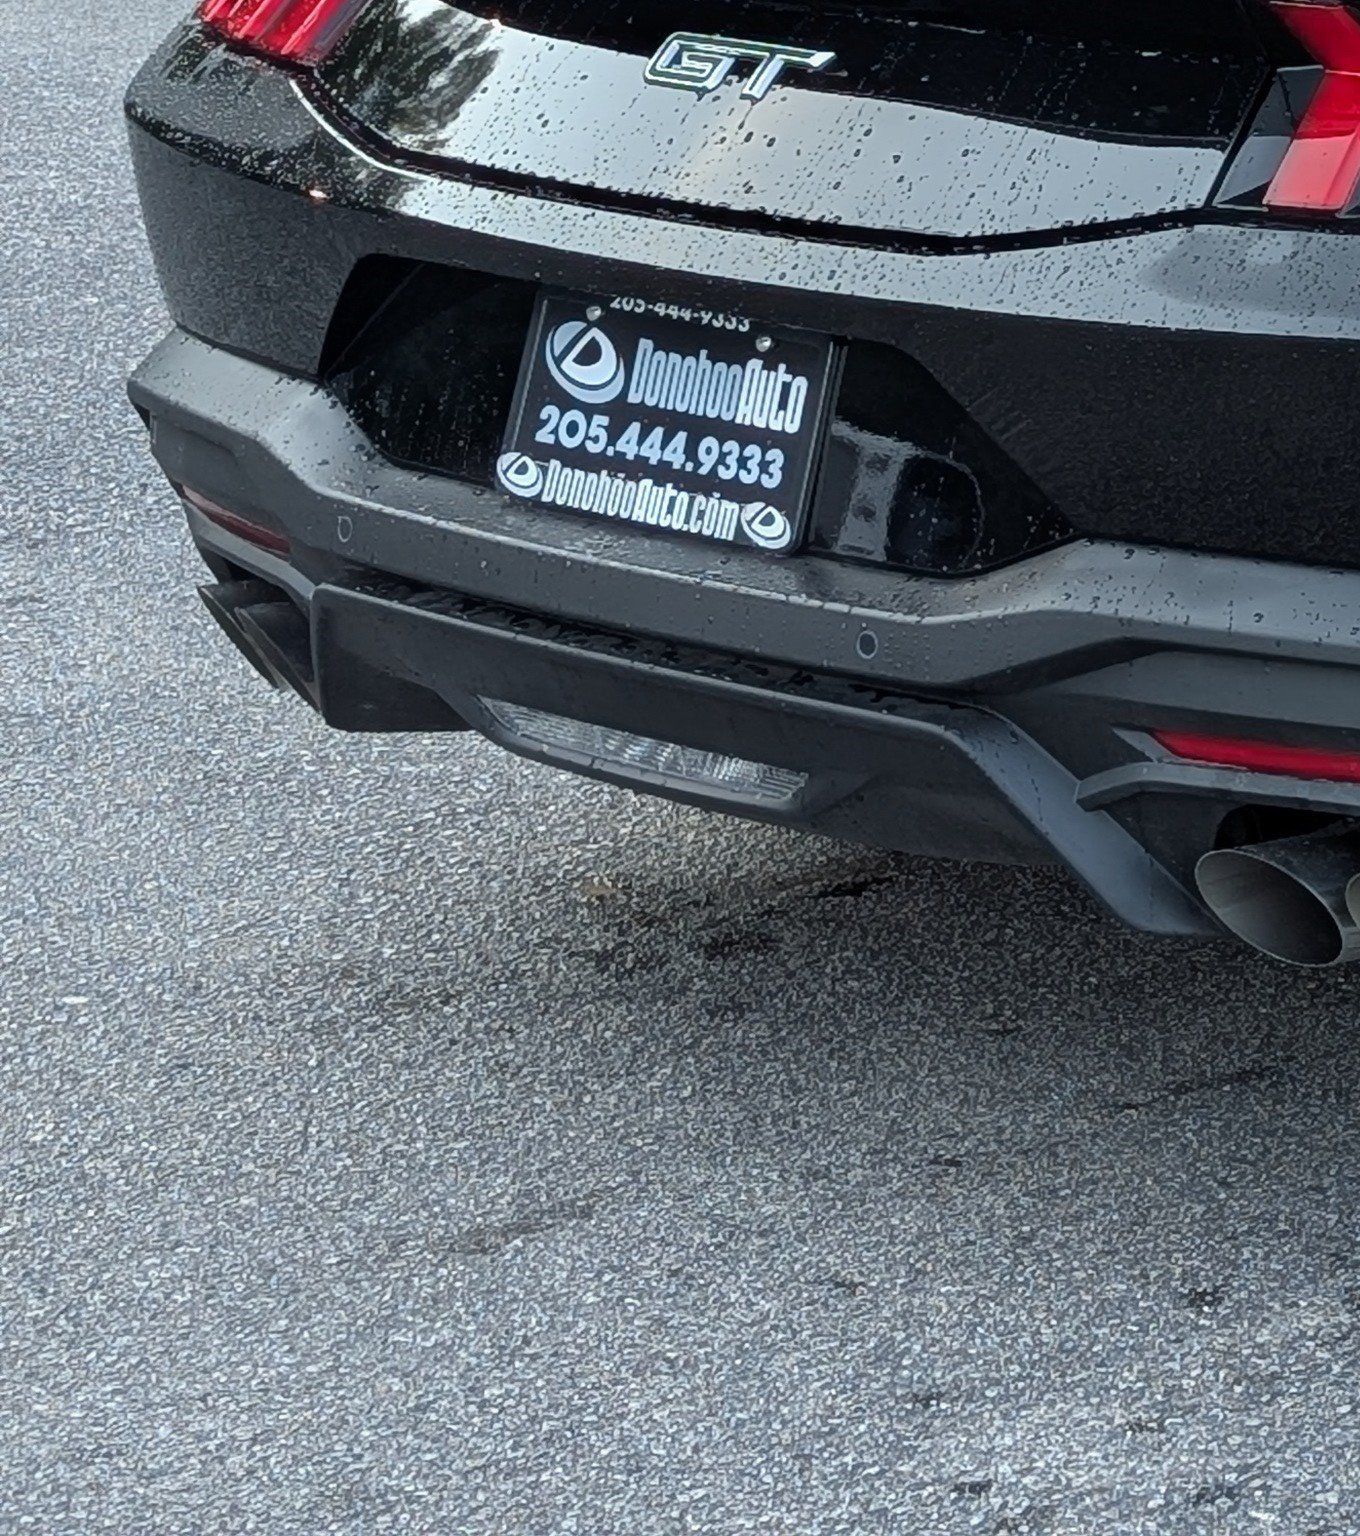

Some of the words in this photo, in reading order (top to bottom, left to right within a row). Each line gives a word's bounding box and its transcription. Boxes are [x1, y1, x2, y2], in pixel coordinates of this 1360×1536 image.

[644, 32, 836, 99] GT
[627, 338, 808, 433] DonohooAuto
[535, 405, 785, 489] 205.444.9333
[541, 458, 740, 541] DonohooAuto.com
